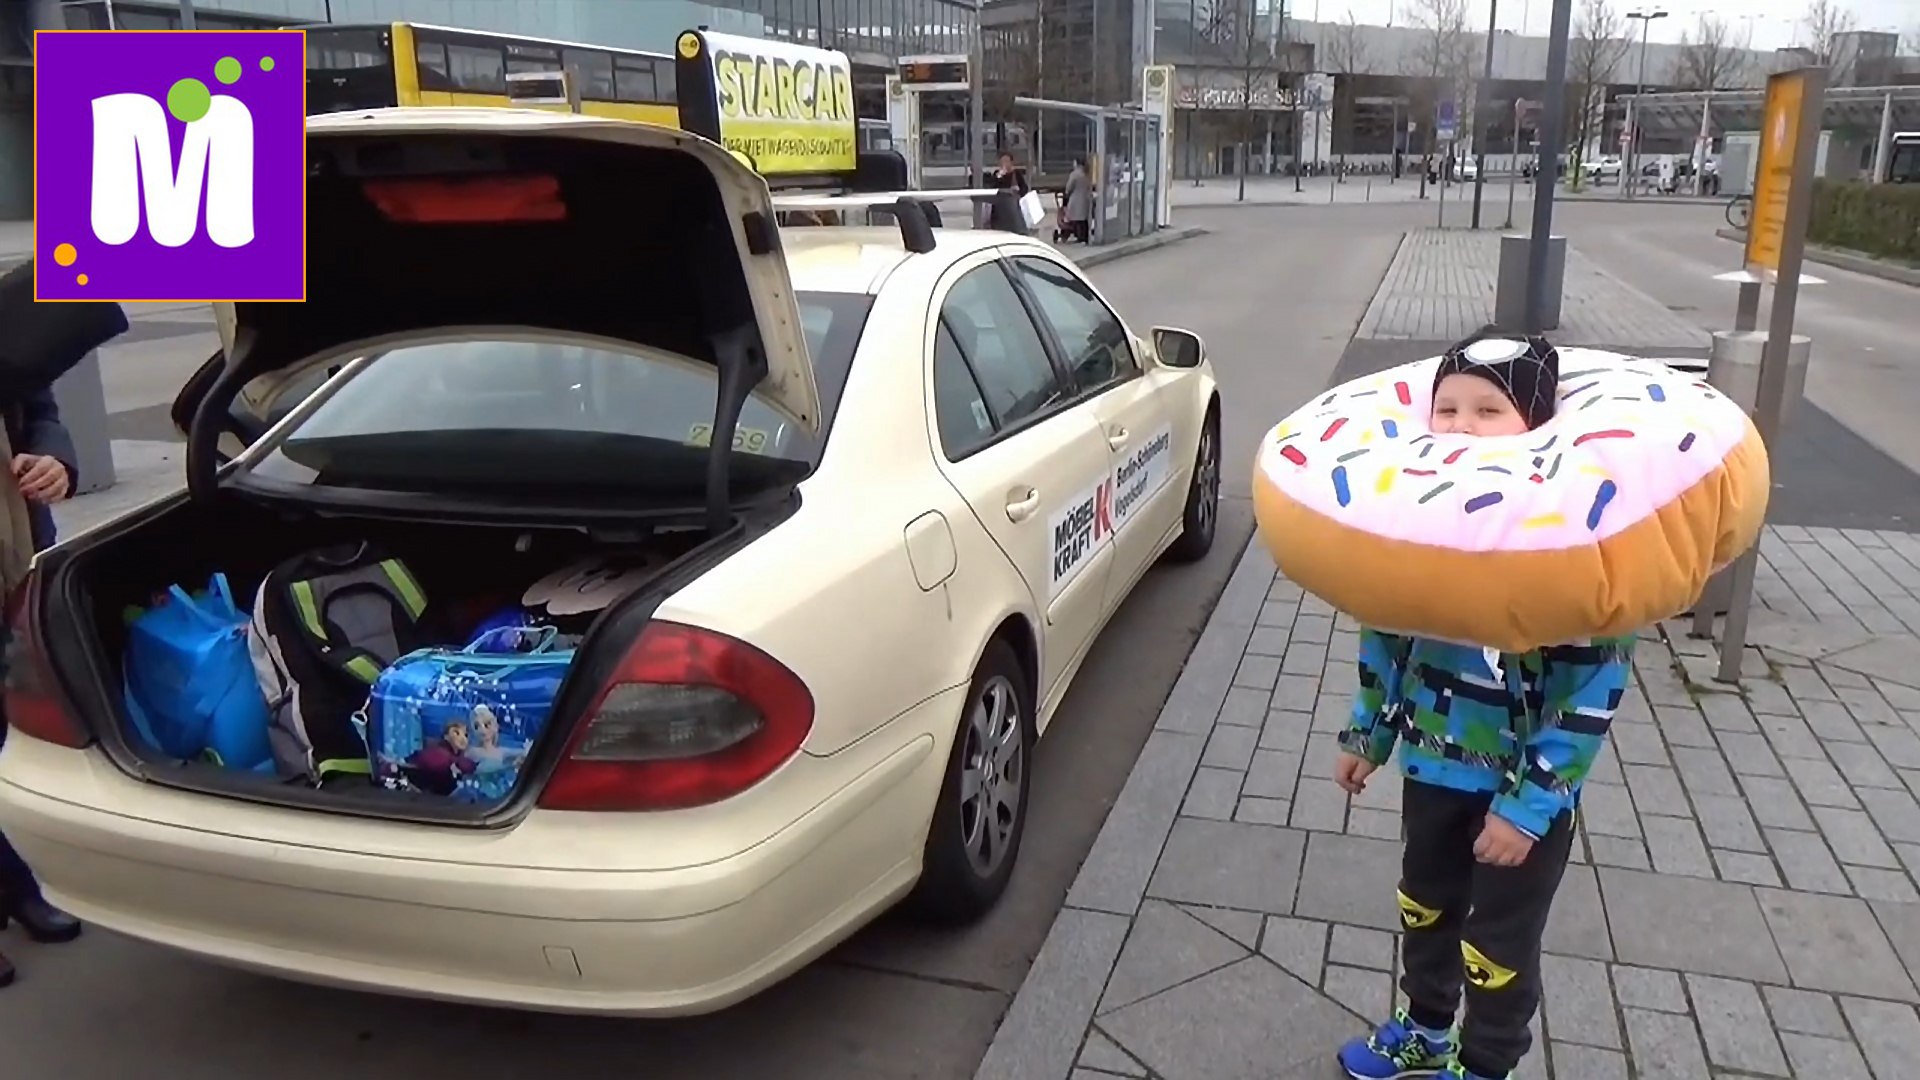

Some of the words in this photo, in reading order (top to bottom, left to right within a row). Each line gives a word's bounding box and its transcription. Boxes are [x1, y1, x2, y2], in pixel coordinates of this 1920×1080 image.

[714, 50, 849, 121] STARCAR
[692, 425, 766, 451] 769
[1053, 526, 1092, 582] KRAFT
